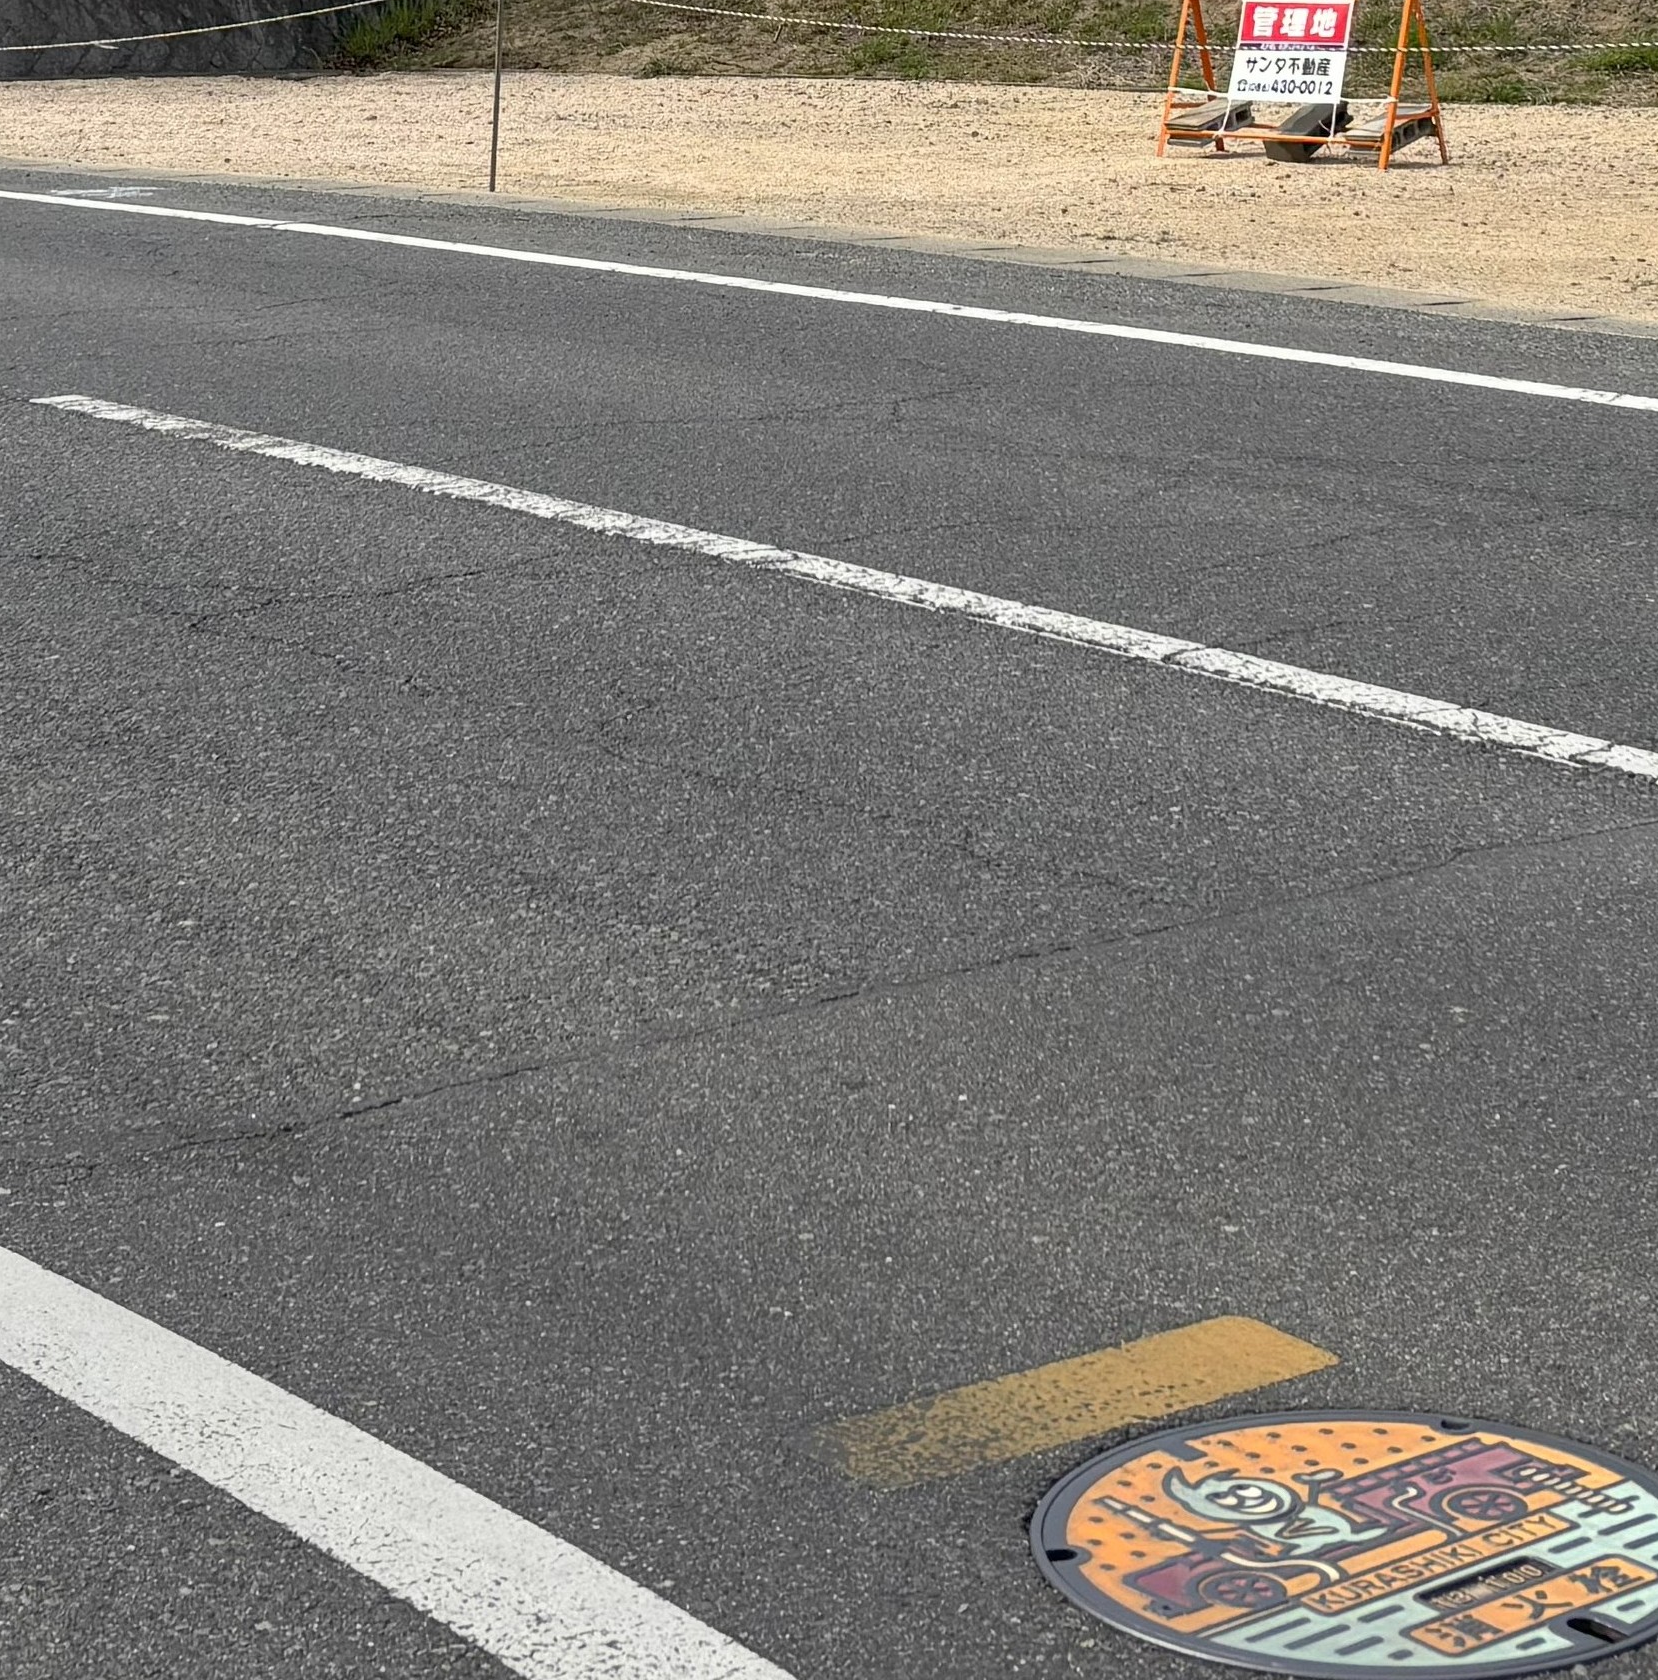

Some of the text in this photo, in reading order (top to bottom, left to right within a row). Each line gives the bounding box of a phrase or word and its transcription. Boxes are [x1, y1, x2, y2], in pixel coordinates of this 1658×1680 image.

[1252, 5, 1338, 38] 管理地
[1246, 56, 1332, 76] サンタ不動産
[1308, 1515, 1558, 1611] KURASHIKI CITY
[1424, 1565, 1646, 1648] 消火栓
